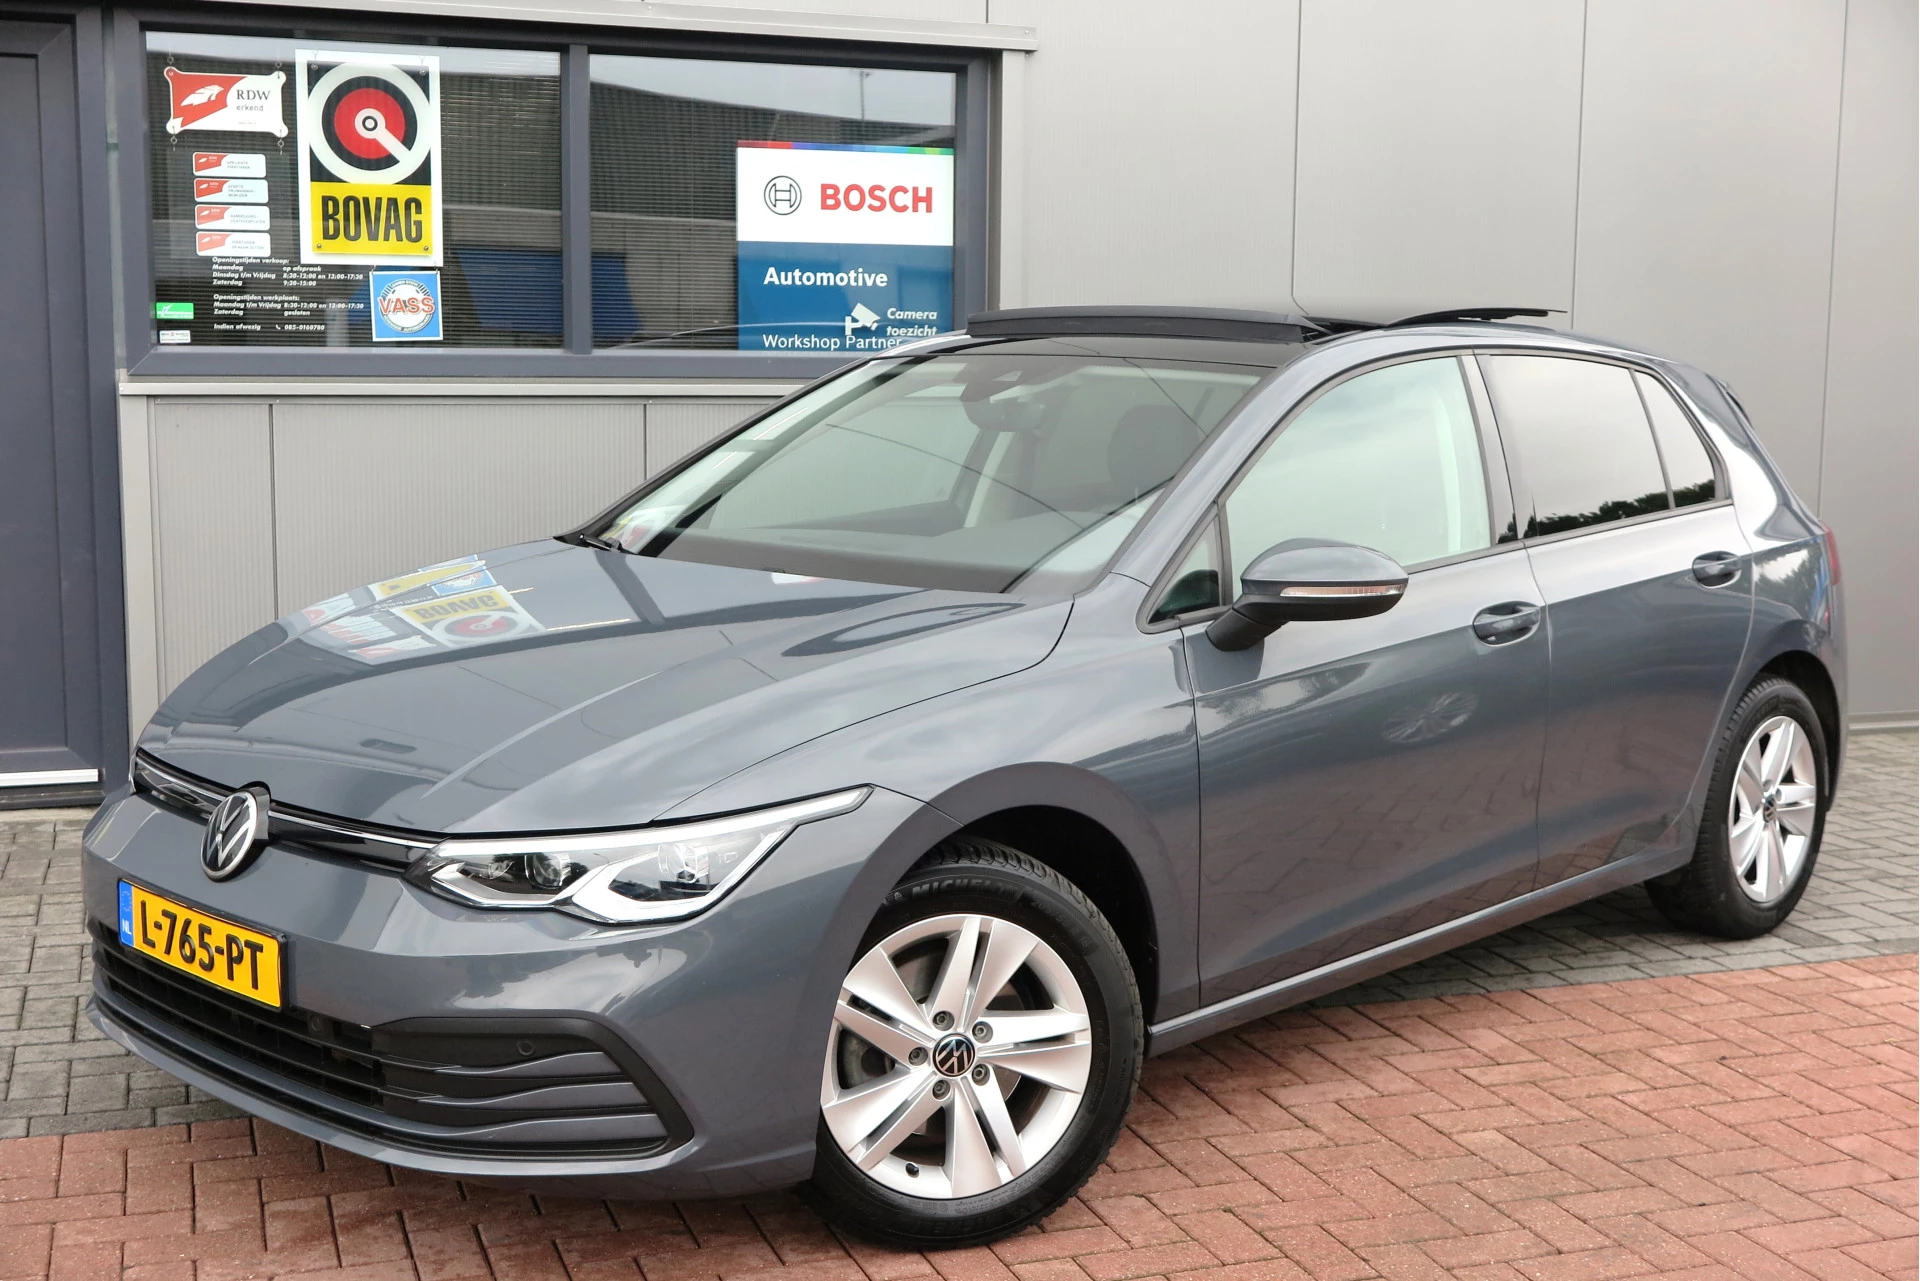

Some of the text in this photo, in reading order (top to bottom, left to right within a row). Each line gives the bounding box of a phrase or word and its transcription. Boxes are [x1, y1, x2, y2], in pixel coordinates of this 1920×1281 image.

[236, 89, 271, 101] RDW
[236, 103, 264, 112] erkend
[820, 183, 933, 214] BOSCH
[321, 195, 423, 243] BOVAG
[212, 256, 290, 265] Openingstijden verkoop:
[212, 264, 244, 272] Maandag
[292, 264, 322, 273] afspraak
[212, 271, 239, 279] Dinsdag
[253, 272, 276, 280] Vrijdag
[763, 266, 889, 287] Automotive
[212, 279, 243, 287] Zaterdag
[213, 293, 300, 302] Openingstijden werkplaats:
[213, 301, 245, 309] Maandag
[378, 296, 435, 314] VASS
[213, 308, 244, 316] Zaterdag
[887, 307, 938, 320] Camera
[235, 323, 261, 331] afwezig
[886, 324, 938, 337] toezicht
[763, 334, 903, 352] Workshop Partner
[121, 918, 133, 935] NL
[140, 899, 264, 991] L-765-PT
